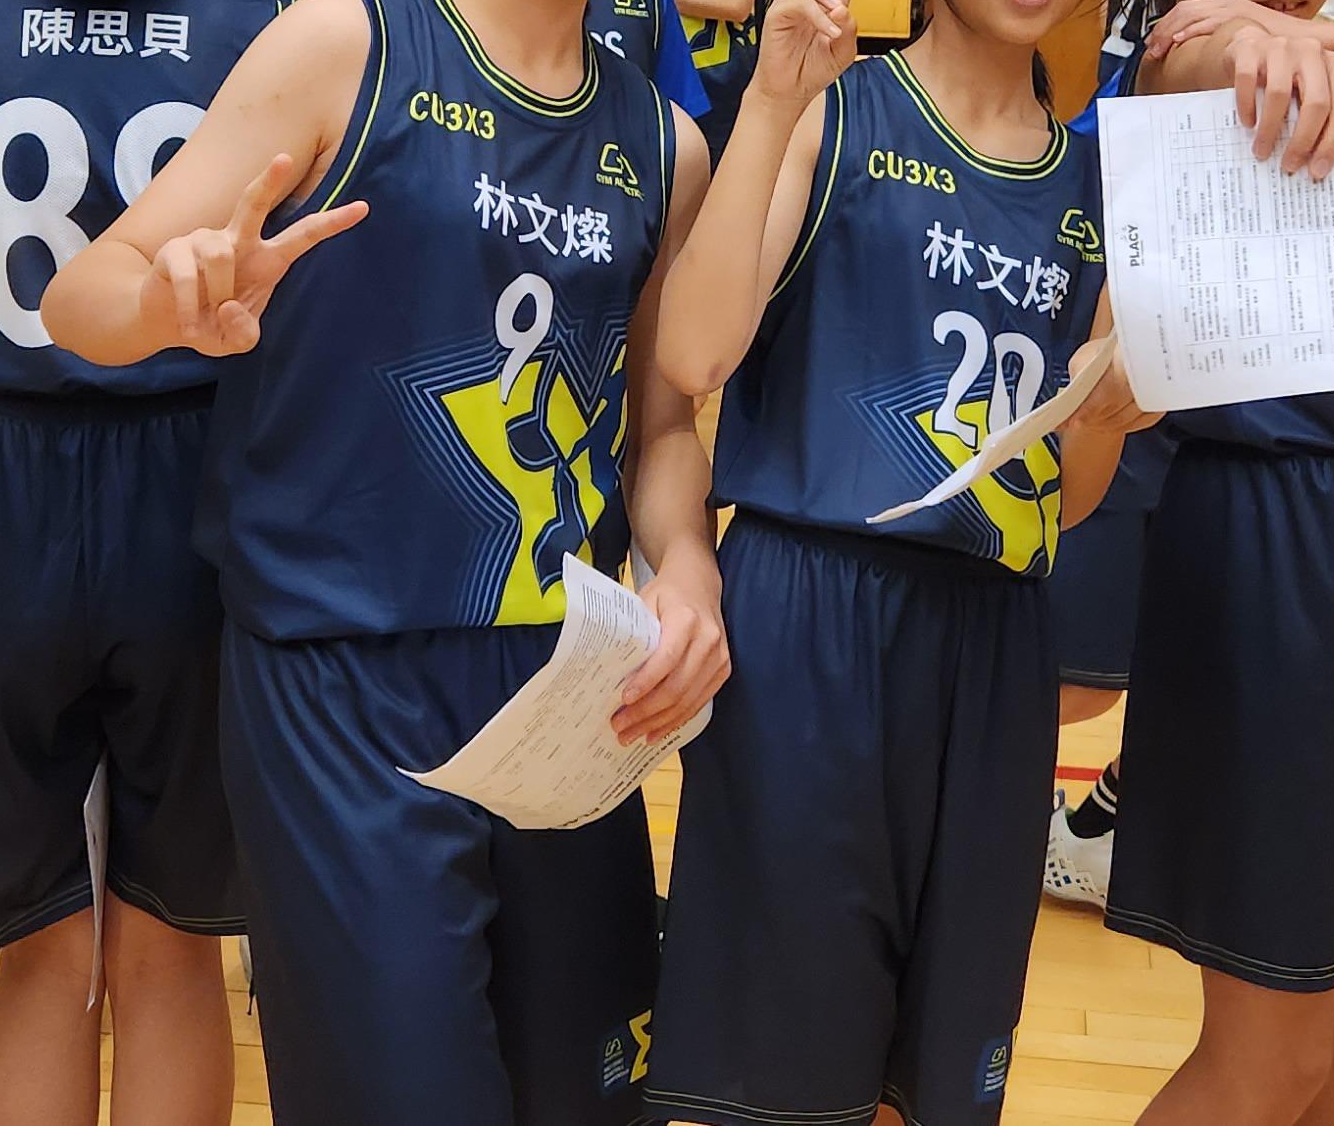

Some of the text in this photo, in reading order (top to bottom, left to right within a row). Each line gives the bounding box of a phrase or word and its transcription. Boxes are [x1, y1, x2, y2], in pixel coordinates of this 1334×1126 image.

[21, 8, 192, 62] 陳思貝
[409, 91, 496, 140] CU3X3
[867, 149, 956, 194] CU3X3
[473, 172, 613, 264] 林文燦
[1129, 224, 1141, 267] PLACY
[923, 220, 1071, 320] 林文燦
[494, 272, 554, 405] 9
[933, 310, 1046, 460] 20
